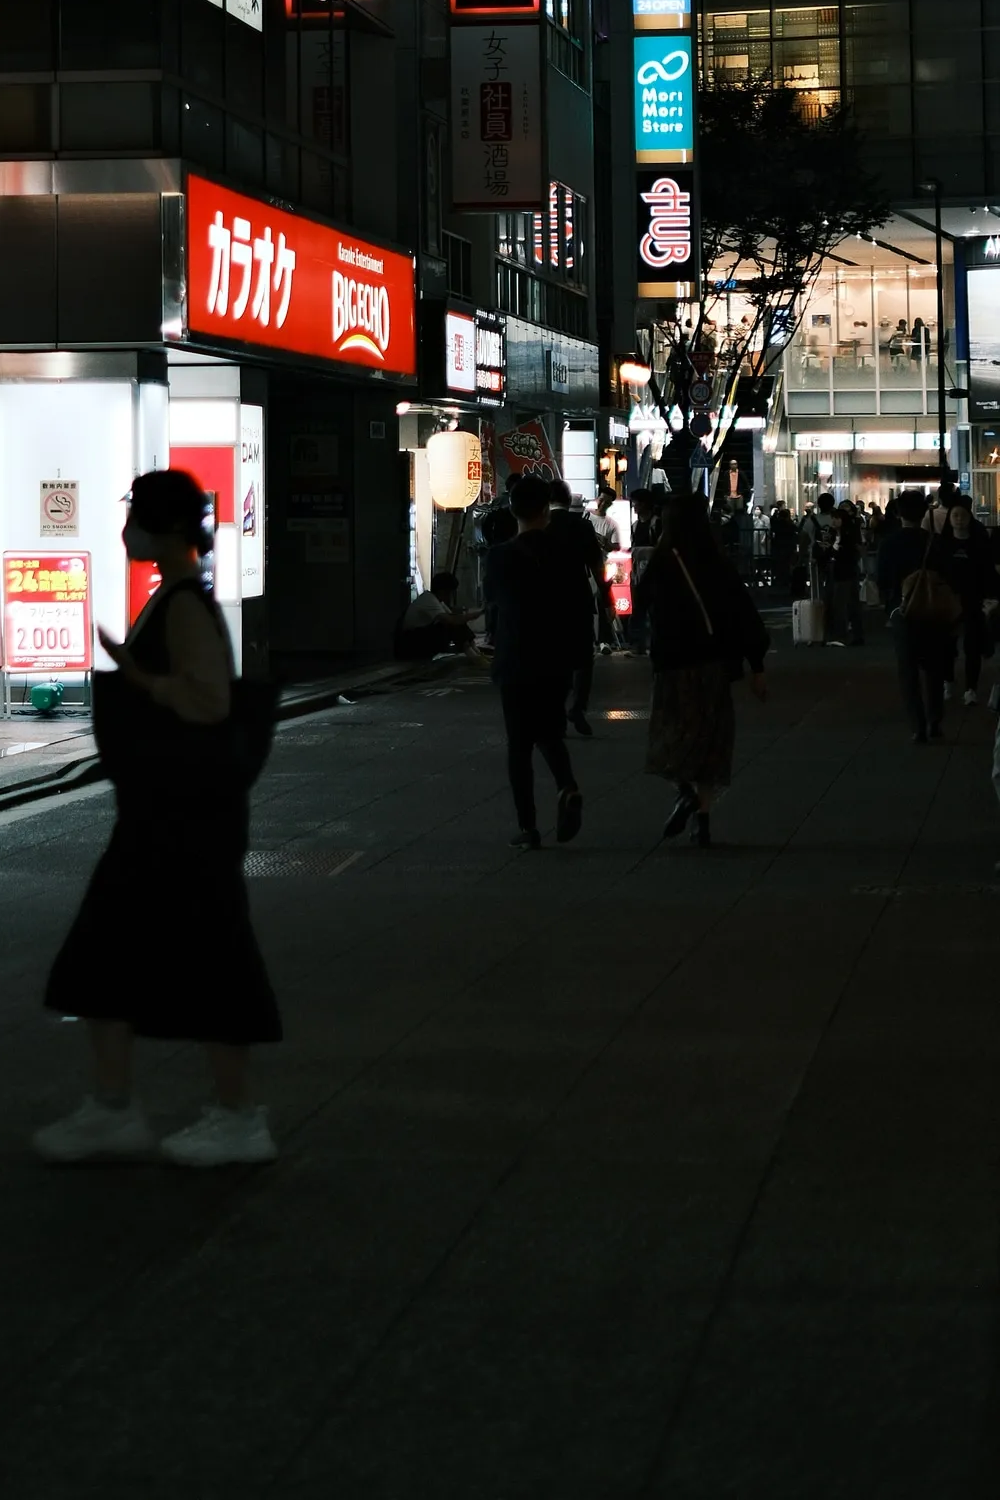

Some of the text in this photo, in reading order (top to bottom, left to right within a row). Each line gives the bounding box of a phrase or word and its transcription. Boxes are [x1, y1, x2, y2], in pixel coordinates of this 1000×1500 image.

[653, 0, 686, 11] OPEN
[642, 88, 684, 103] Mori
[481, 30, 512, 197] 女子社員酒場
[642, 103, 684, 118] Mori
[642, 120, 684, 134] Store
[640, 177, 691, 268] HUB
[207, 210, 296, 329] カラオケ
[338, 242, 385, 275] Karaoke Entertainment
